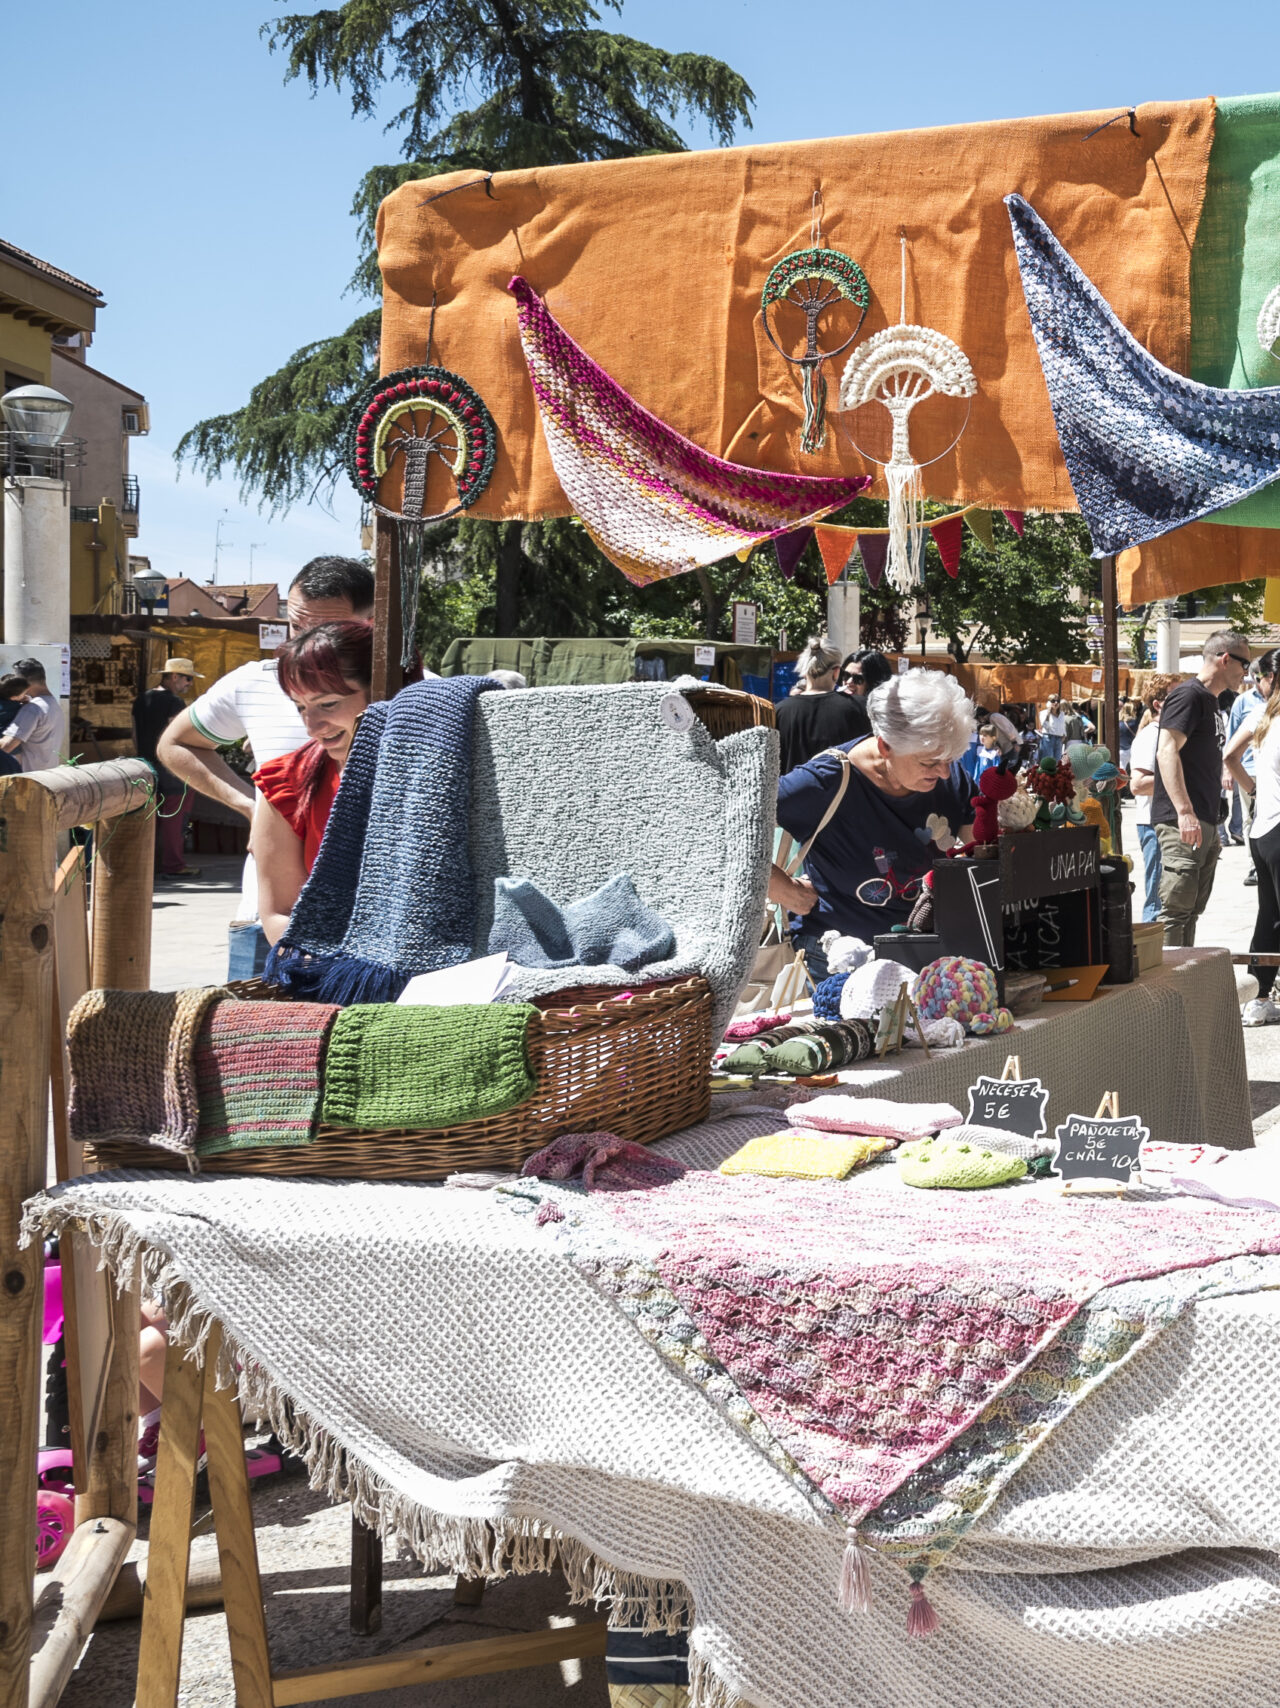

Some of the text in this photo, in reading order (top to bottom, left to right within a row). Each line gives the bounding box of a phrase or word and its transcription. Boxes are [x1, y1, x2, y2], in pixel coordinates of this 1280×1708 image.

[1051, 852, 1076, 881] UNA
[979, 1083, 1040, 1098] NECESER
[984, 1102, 1010, 1119] 5€
[1070, 1123, 1140, 1140] PAÑOLETAS
[1084, 1136, 1106, 1149] 5€
[1065, 1149, 1106, 1161] CHAL
